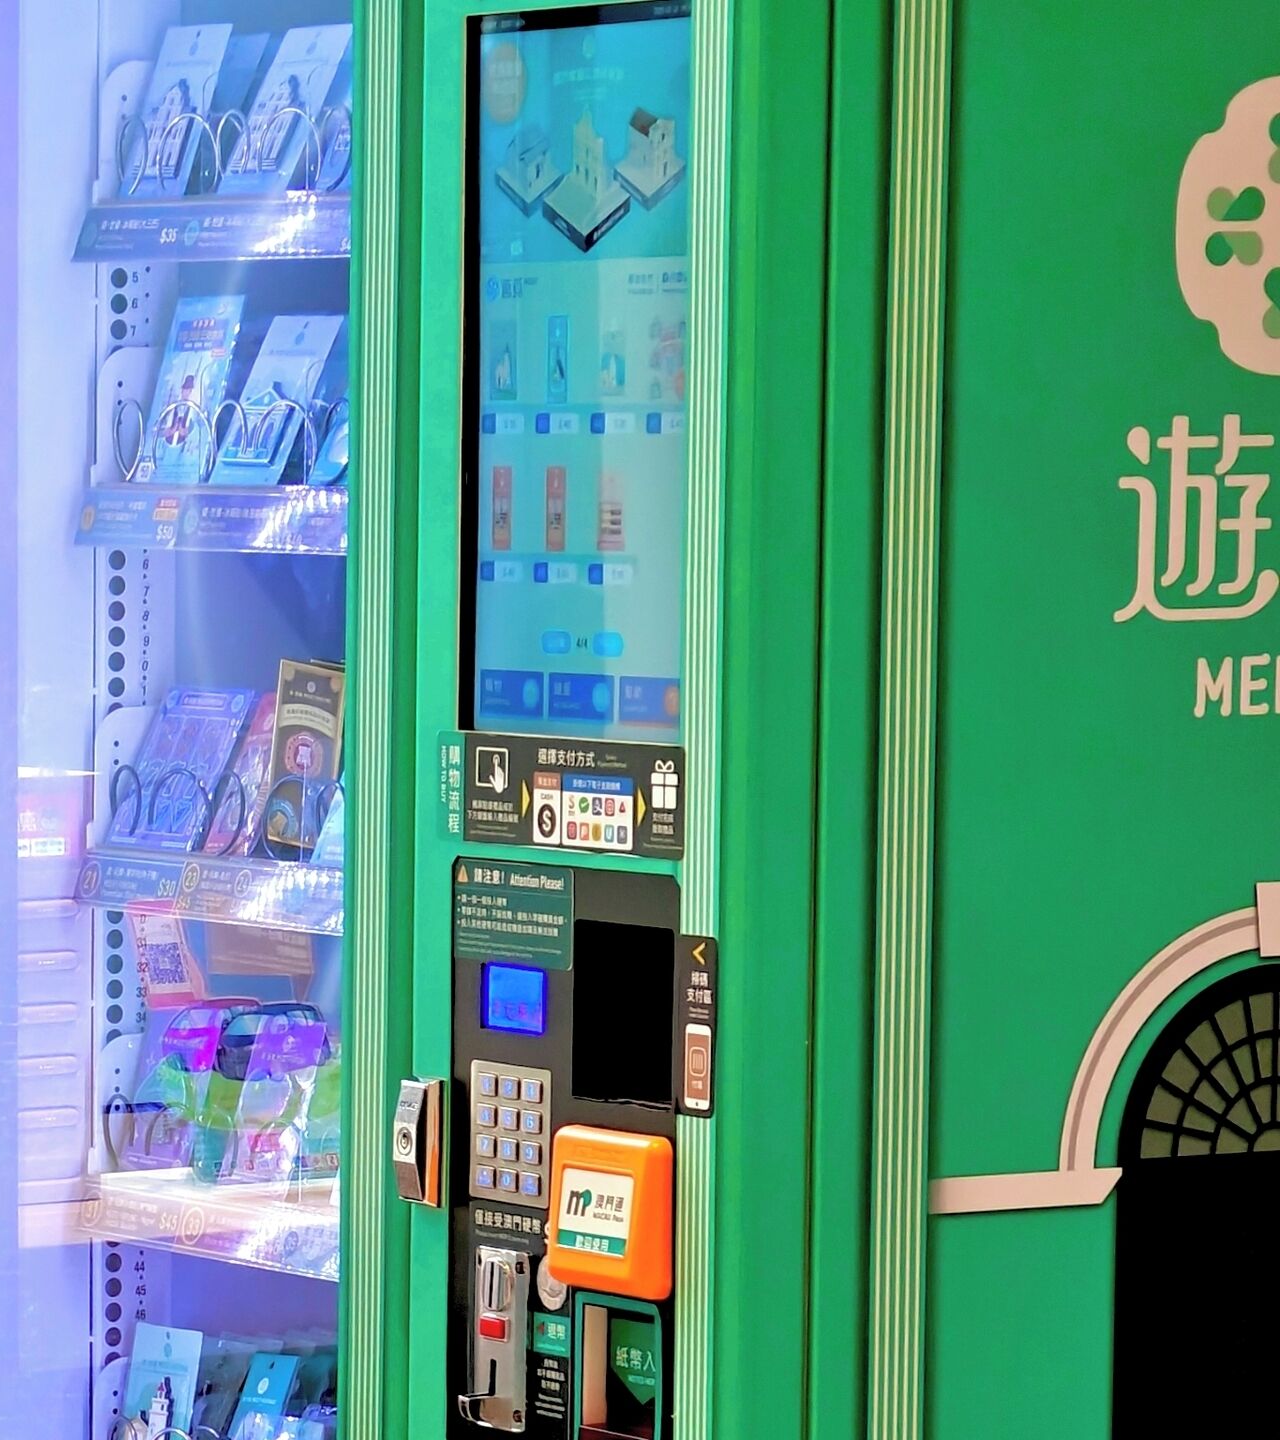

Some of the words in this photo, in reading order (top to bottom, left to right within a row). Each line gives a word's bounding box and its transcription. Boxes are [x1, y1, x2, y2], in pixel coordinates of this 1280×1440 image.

[1113, 413, 1280, 623] 遊
[1194, 652, 1280, 718] ME
[537, 748, 596, 769] 選擇支付方式
[135, 1285, 146, 1296] 45
[615, 1345, 656, 1372] 紙幣入
